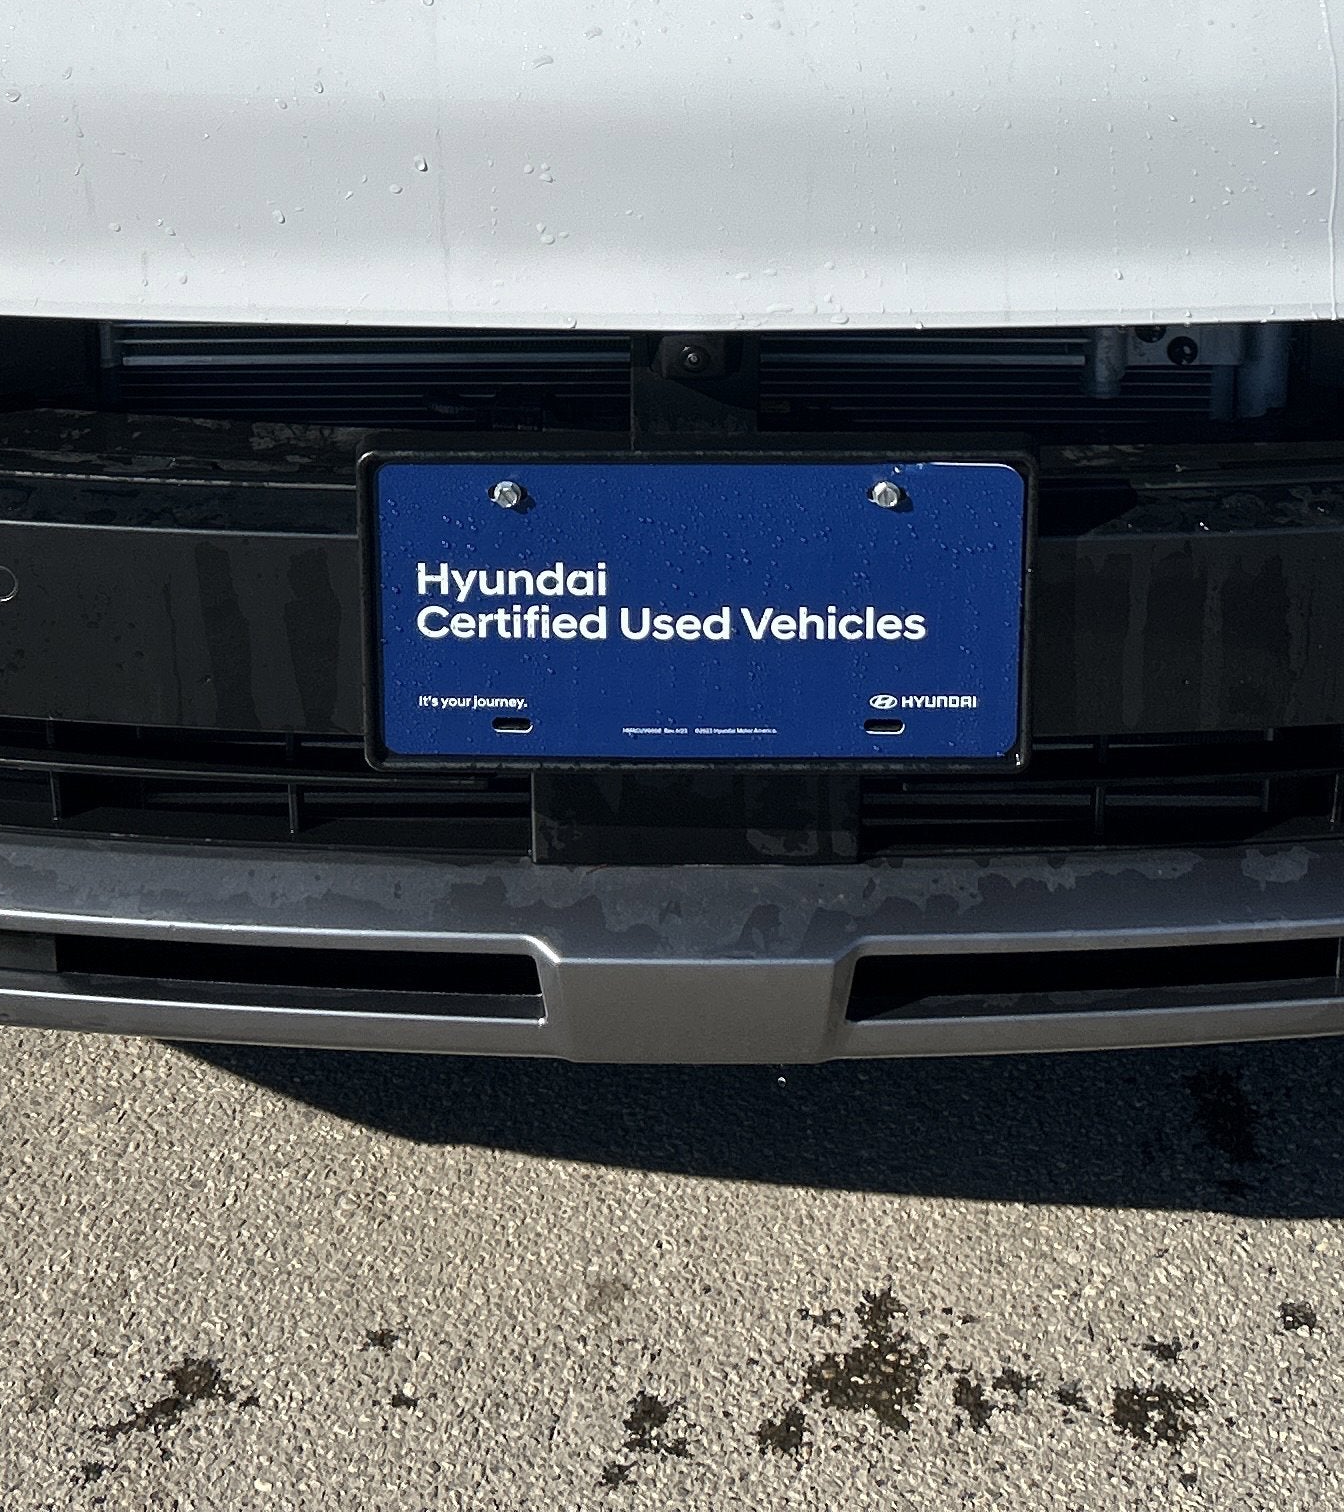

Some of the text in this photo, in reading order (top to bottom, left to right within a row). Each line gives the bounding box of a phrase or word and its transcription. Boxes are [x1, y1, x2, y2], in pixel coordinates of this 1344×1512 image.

[416, 562, 607, 602] Hyundai
[417, 605, 927, 640] Certified Used Vehicles
[418, 695, 528, 710] It's your journey.
[901, 695, 977, 708] HYUNDAI
